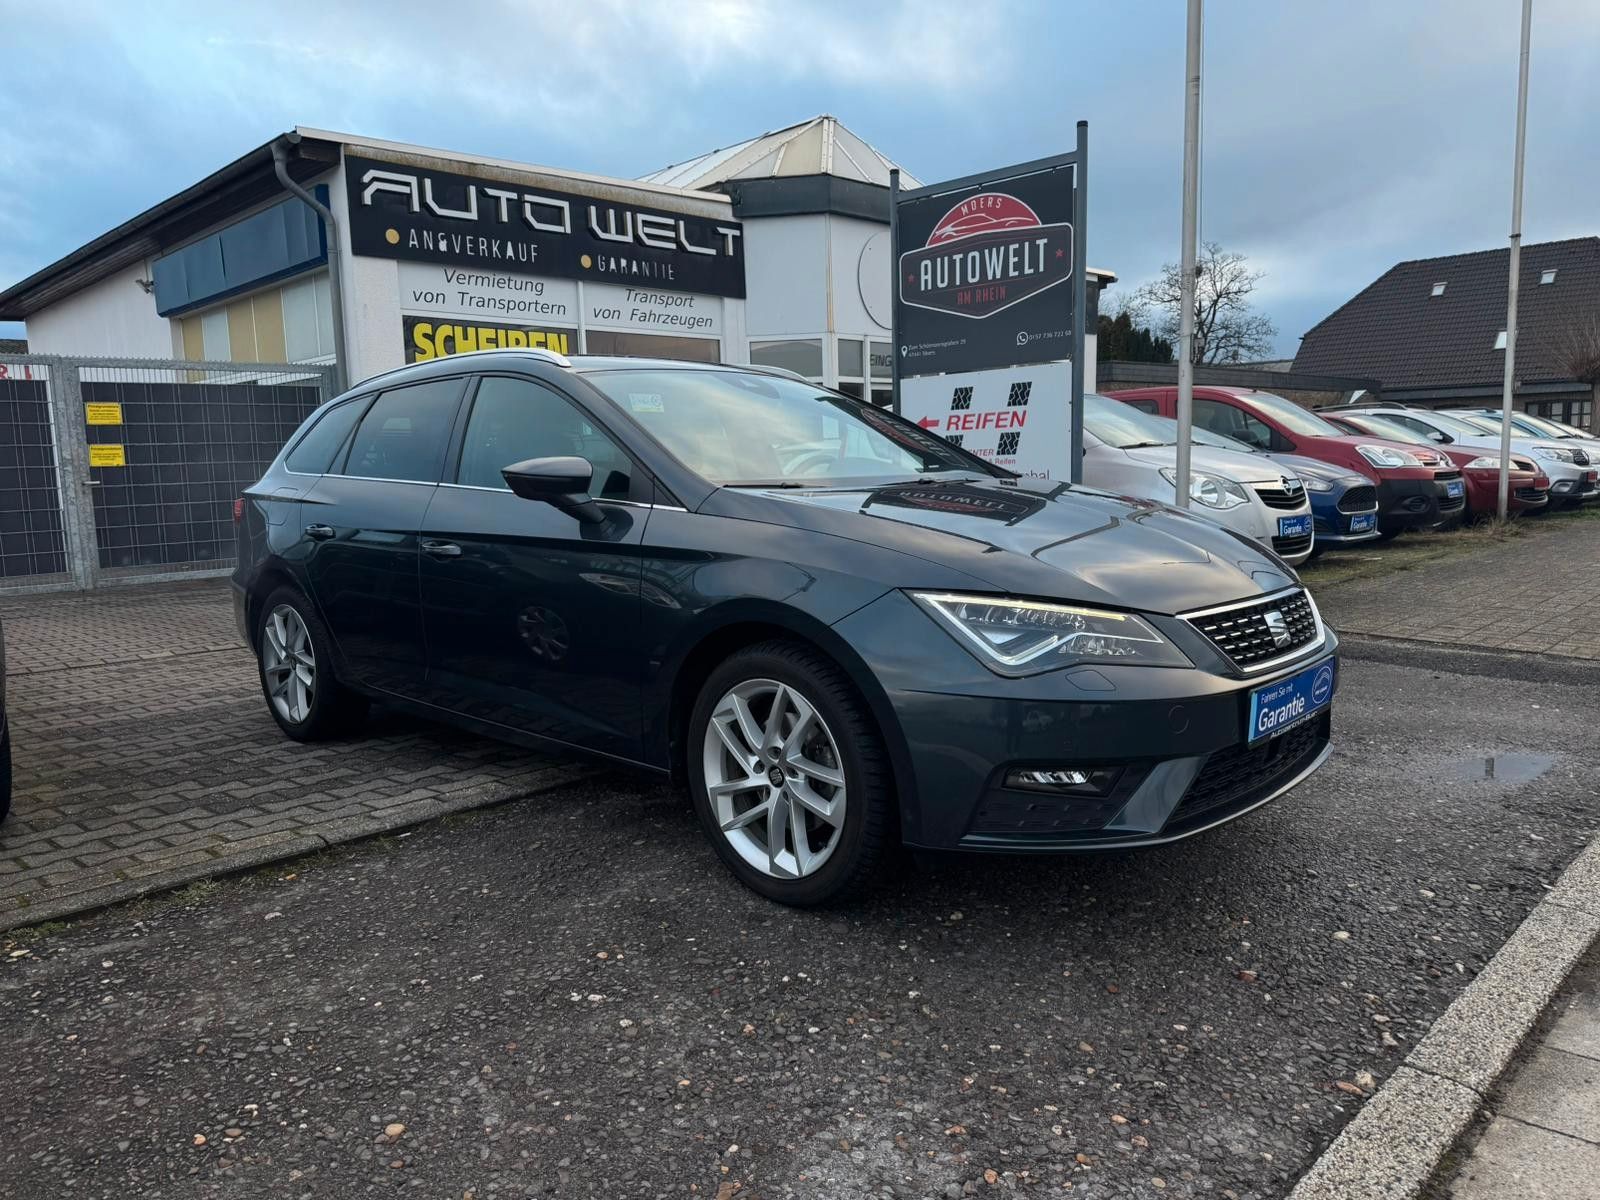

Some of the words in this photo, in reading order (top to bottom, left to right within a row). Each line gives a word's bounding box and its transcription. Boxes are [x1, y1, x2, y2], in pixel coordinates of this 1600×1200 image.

[361, 169, 572, 234] AUTO
[587, 205, 741, 257] WELT
[960, 196, 1003, 216] MOERS
[408, 228, 539, 264] AN&VERKAUF
[920, 238, 1048, 292] AUTOWELT
[443, 268, 545, 296] Vermietung
[412, 289, 446, 305] von
[457, 291, 567, 316] Transportern
[624, 288, 695, 308] Transport
[592, 306, 621, 320] von
[629, 308, 713, 329] Fahrzeugen
[946, 410, 1027, 431] REIFEN
[1261, 691, 1278, 704] Fahren
[1258, 692, 1305, 732] Garantie
